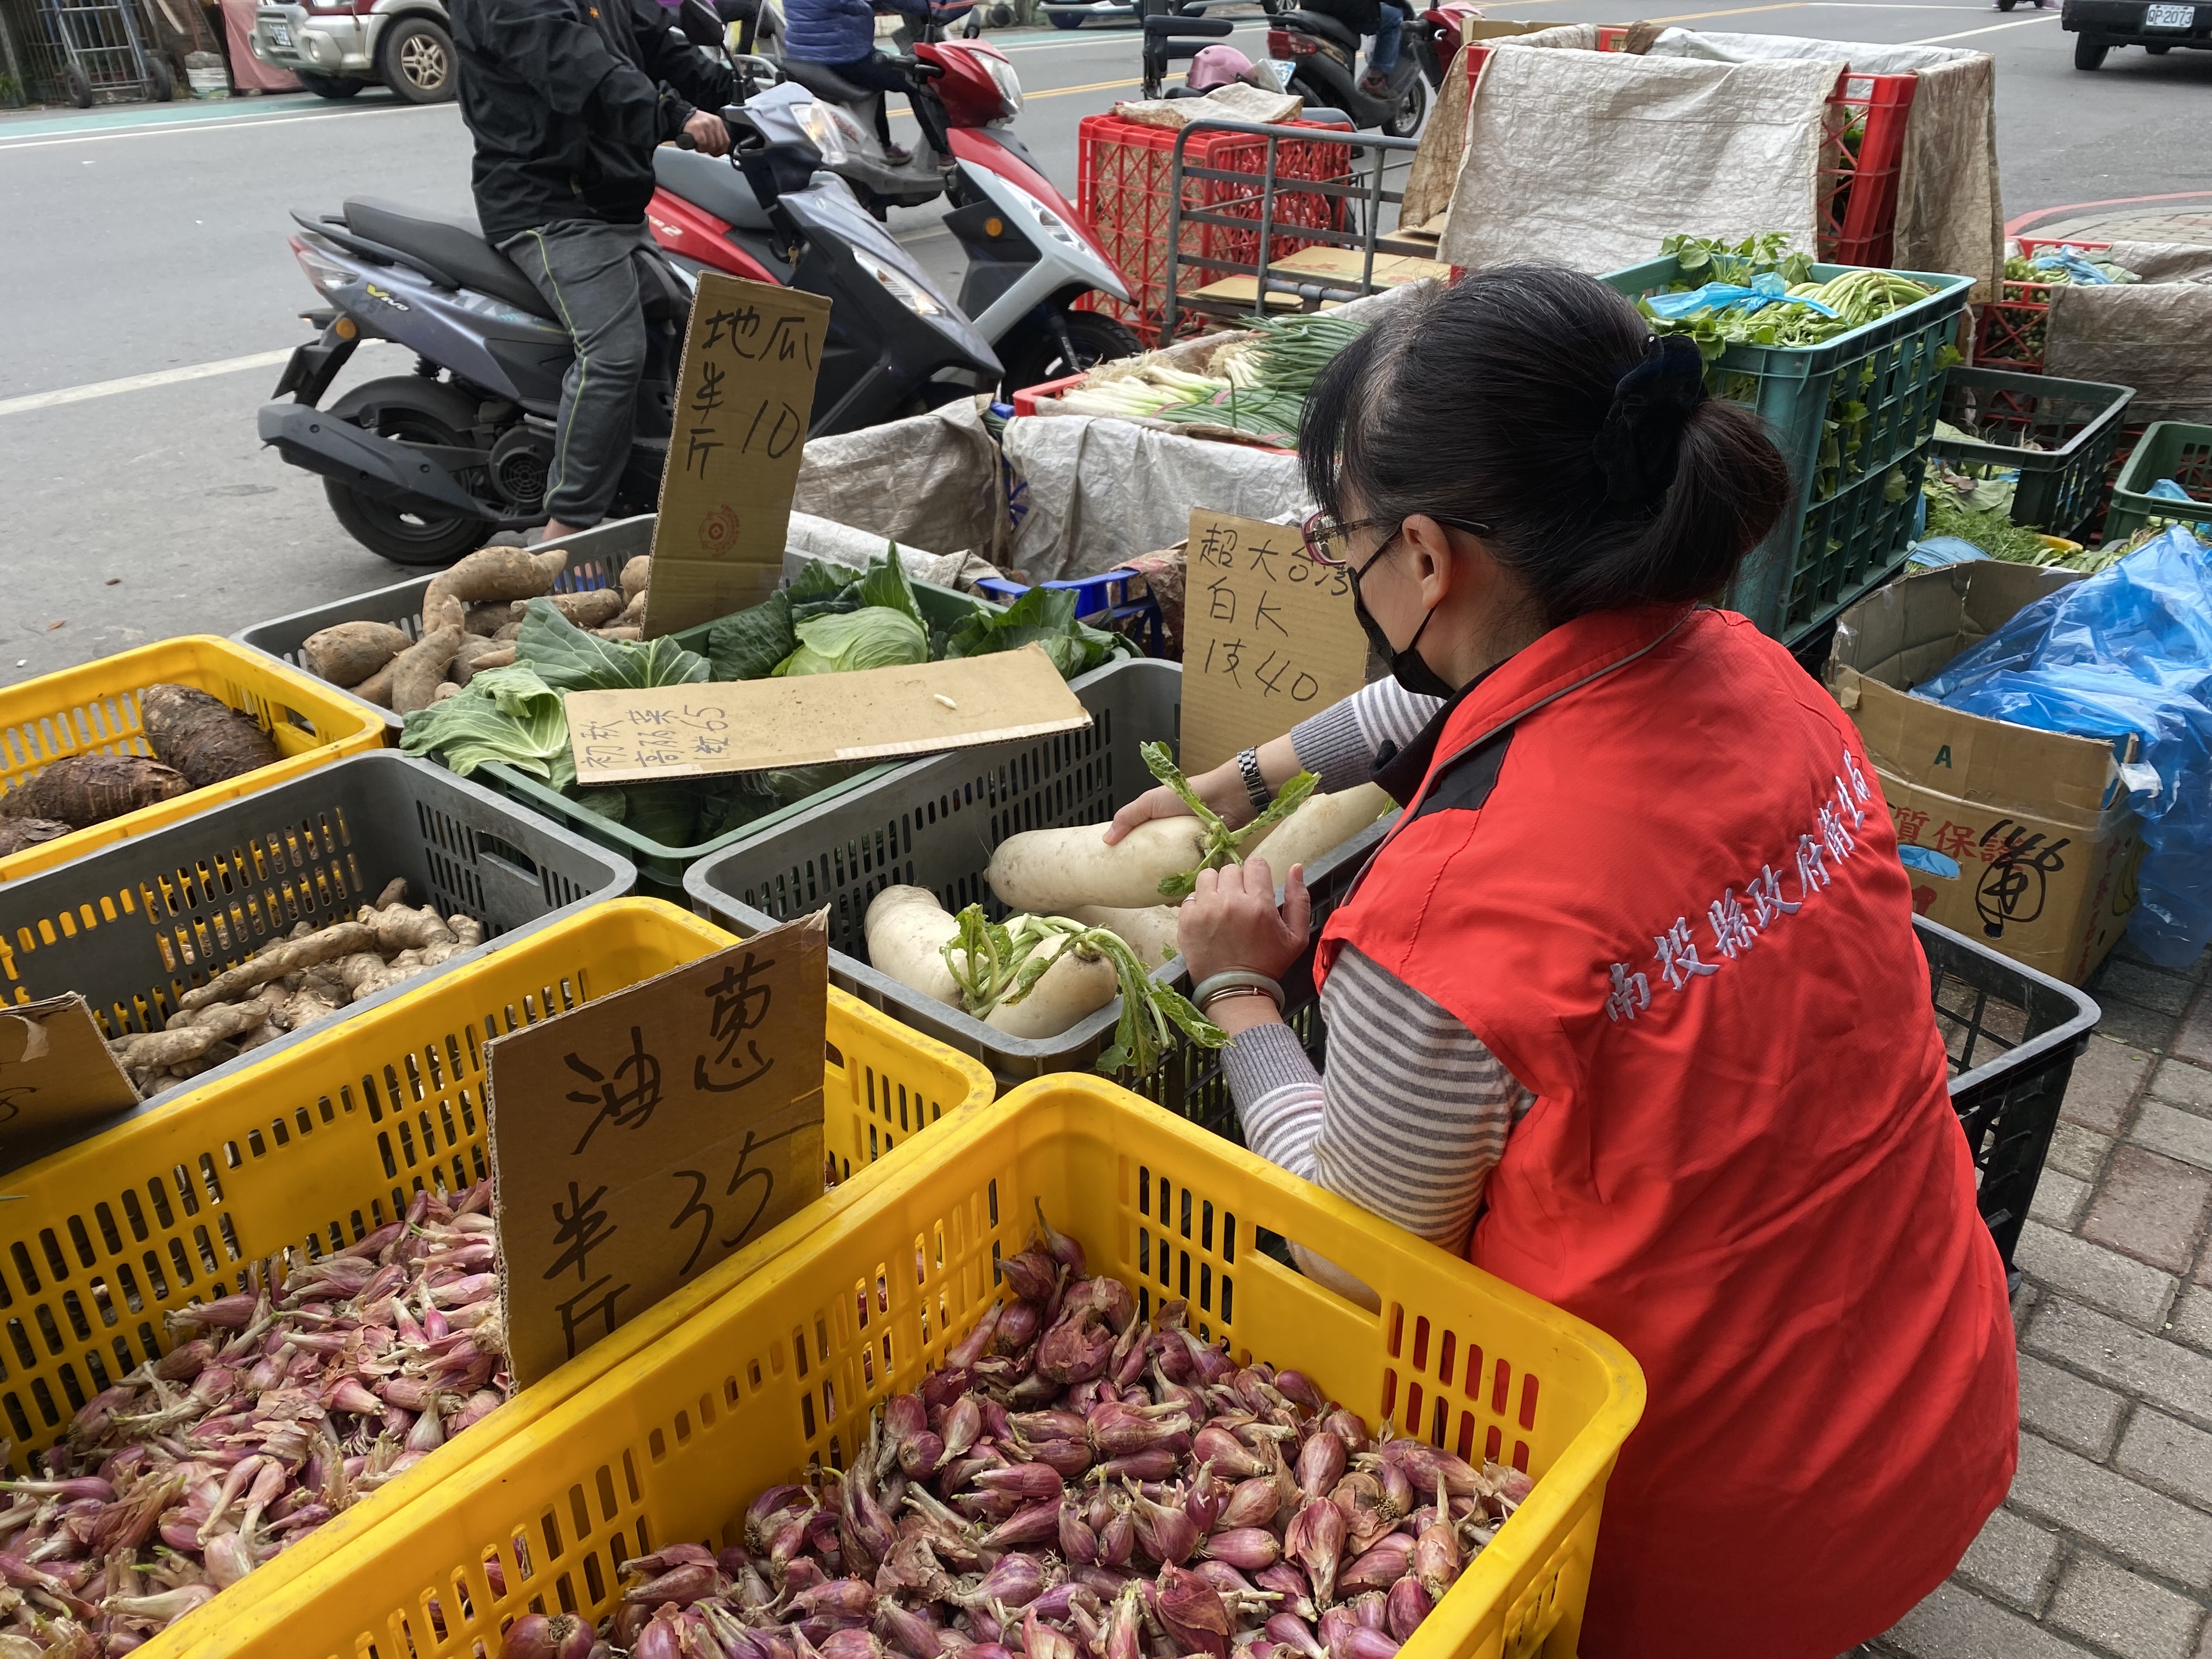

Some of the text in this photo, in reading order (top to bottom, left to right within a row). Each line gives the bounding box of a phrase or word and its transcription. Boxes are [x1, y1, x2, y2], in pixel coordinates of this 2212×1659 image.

[702, 305, 812, 371] 地瓜
[686, 361, 725, 480] 半斤
[742, 399, 800, 458] 10
[1934, 744, 1953, 769] A
[1605, 749, 1871, 1022] 南投縣政府衛生局
[669, 1119, 824, 1276] 35
[543, 1181, 631, 1361] 半斤
